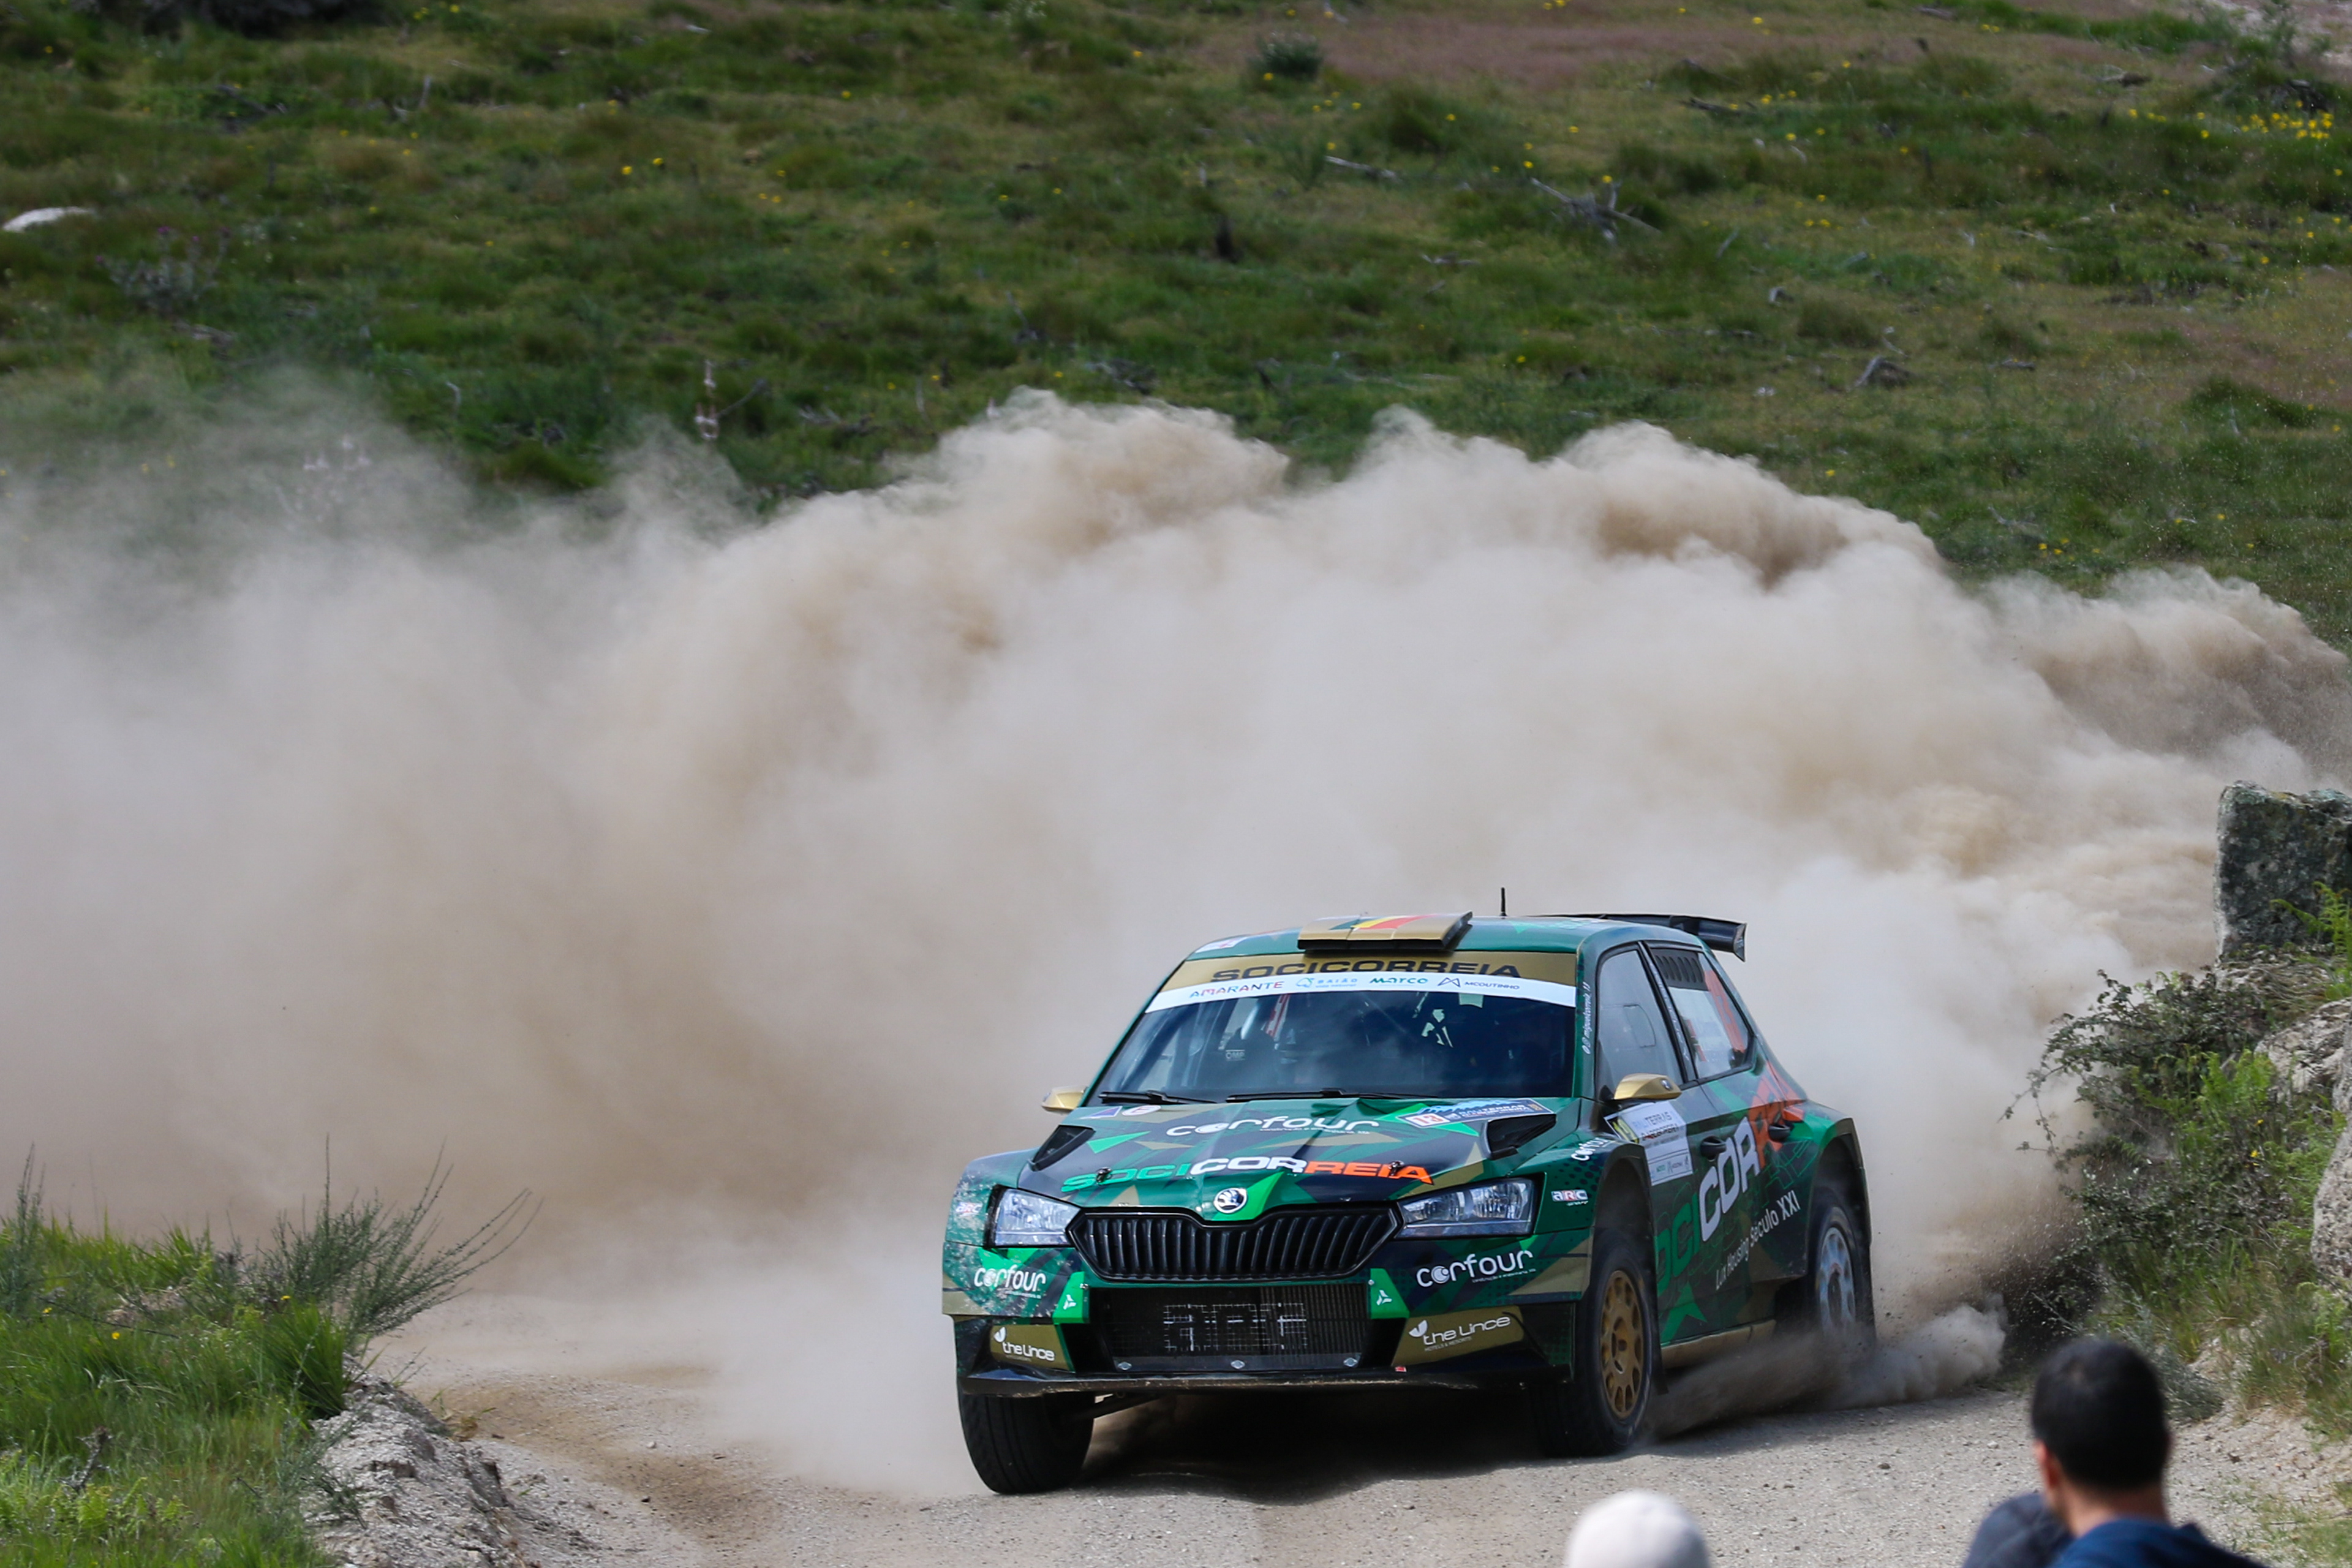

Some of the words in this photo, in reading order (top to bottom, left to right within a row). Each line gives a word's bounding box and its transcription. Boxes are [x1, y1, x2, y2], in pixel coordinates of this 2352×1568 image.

[1211, 960, 1521, 982] SOCICORREIA
[1189, 981, 1284, 998] AMARANTE
[1464, 981, 1520, 990] MCOUTINHO
[1412, 1115, 1443, 1124] 13
[1061, 1156, 1434, 1192] SOCICORREIA
[1776, 1189, 1801, 1220] XXI
[1423, 1329, 1457, 1345] the
[1459, 1316, 1510, 1336] Lince
